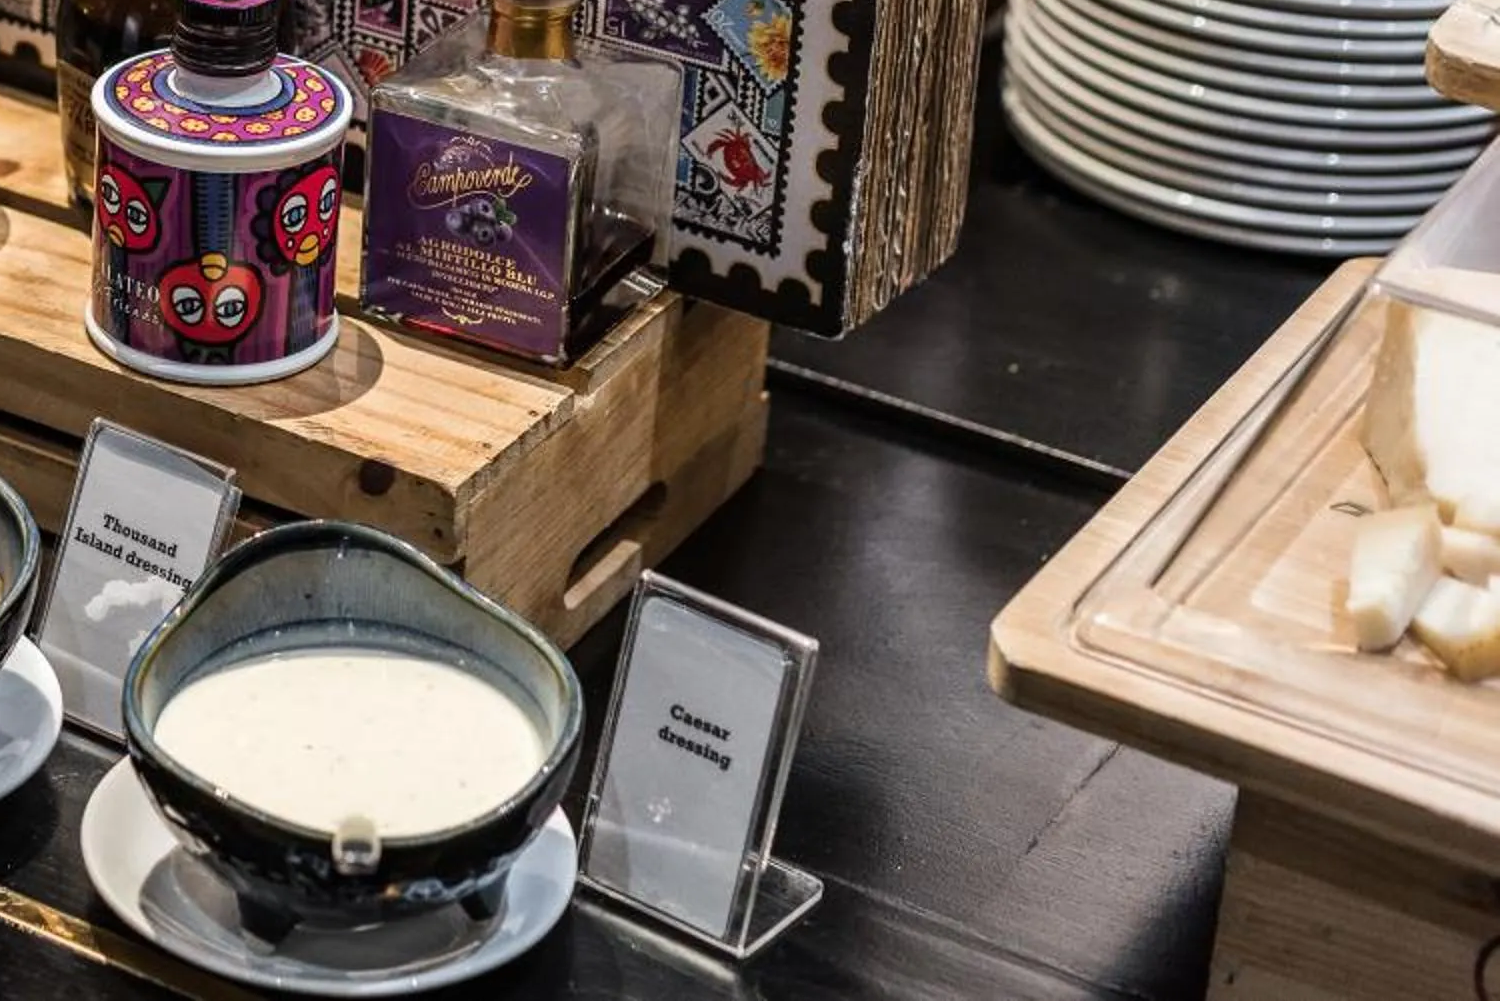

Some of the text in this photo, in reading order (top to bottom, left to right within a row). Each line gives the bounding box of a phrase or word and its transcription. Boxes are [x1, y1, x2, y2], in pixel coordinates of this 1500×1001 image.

[417, 235, 517, 270] AGRODOLCE
[418, 245, 501, 276] MIRTILLO
[505, 267, 538, 286] BLU
[102, 512, 179, 558] Thousand
[73, 525, 194, 593] Island dressing
[669, 703, 731, 742] Caesar
[657, 725, 732, 772] dressing
